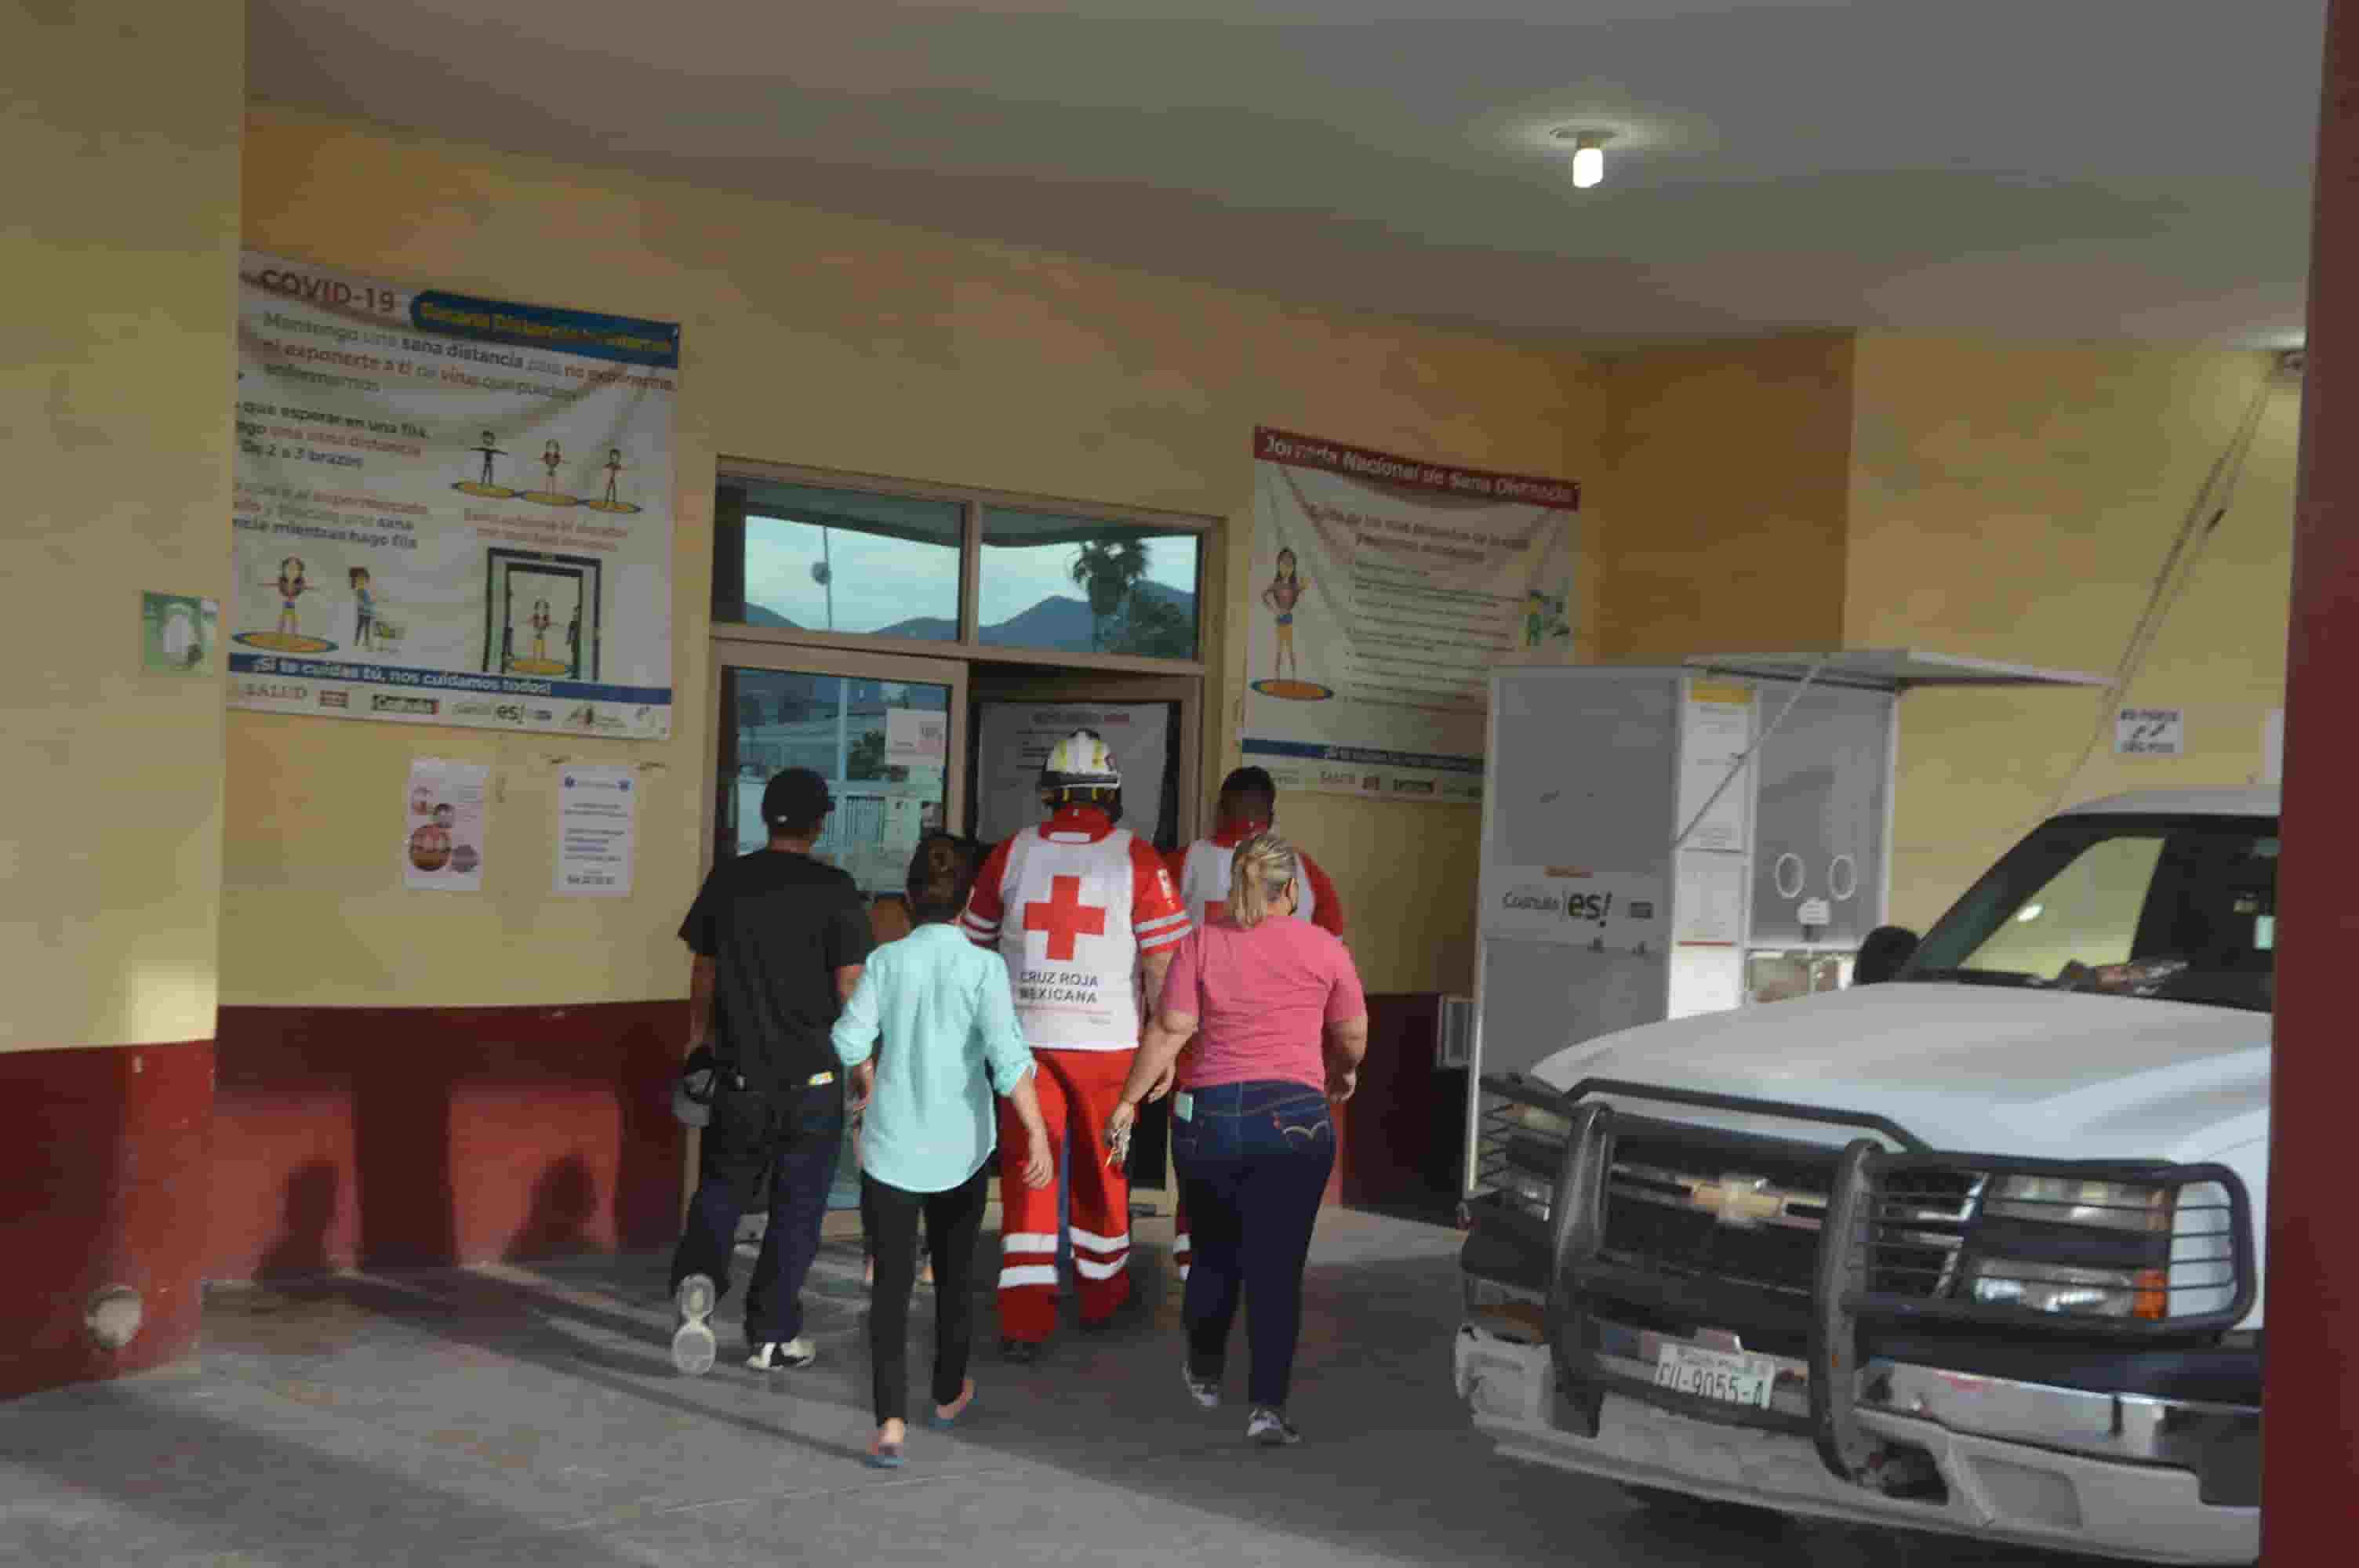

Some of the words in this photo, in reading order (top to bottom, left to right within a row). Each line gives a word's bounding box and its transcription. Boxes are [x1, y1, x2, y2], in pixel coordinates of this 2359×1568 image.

[260, 270, 394, 313] COVID-19
[285, 345, 380, 374] exponerte
[402, 339, 442, 357] sana
[446, 343, 524, 368] distancia
[1343, 450, 1419, 479] Nacional
[1449, 471, 1491, 492] Sana
[389, 671, 419, 685] nos
[422, 672, 499, 691] cuidamos
[1020, 971, 1056, 985] CRUZ
[1060, 972, 1099, 987] ROJA
[1019, 987, 1098, 1004] MEXICANA
